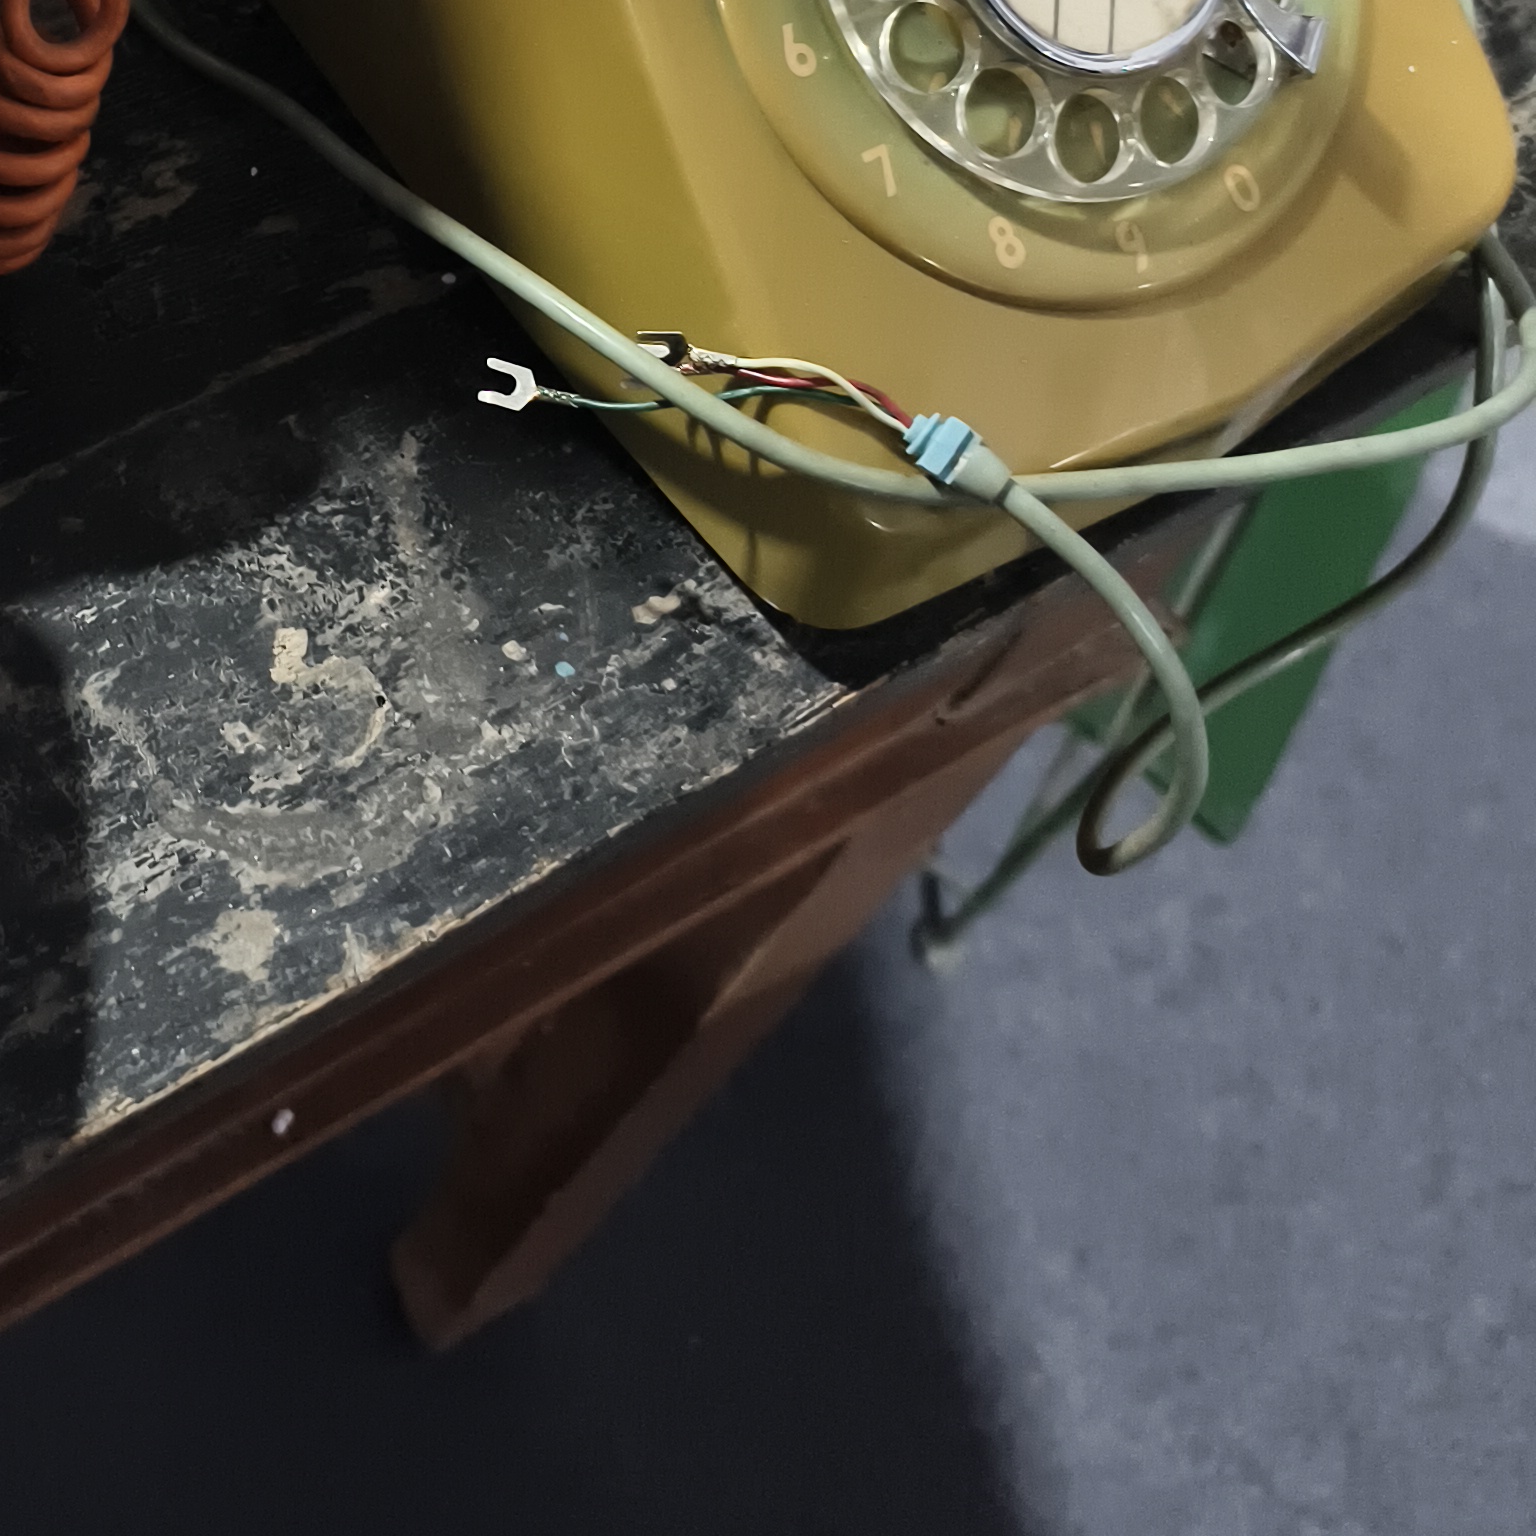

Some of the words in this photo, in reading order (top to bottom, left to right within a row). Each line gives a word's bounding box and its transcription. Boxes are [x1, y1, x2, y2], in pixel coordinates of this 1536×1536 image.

[781, 23, 817, 77] 6
[862, 143, 897, 196] 7
[987, 216, 1026, 269] 8
[1114, 220, 1150, 273] 9
[1223, 164, 1260, 212] 0
